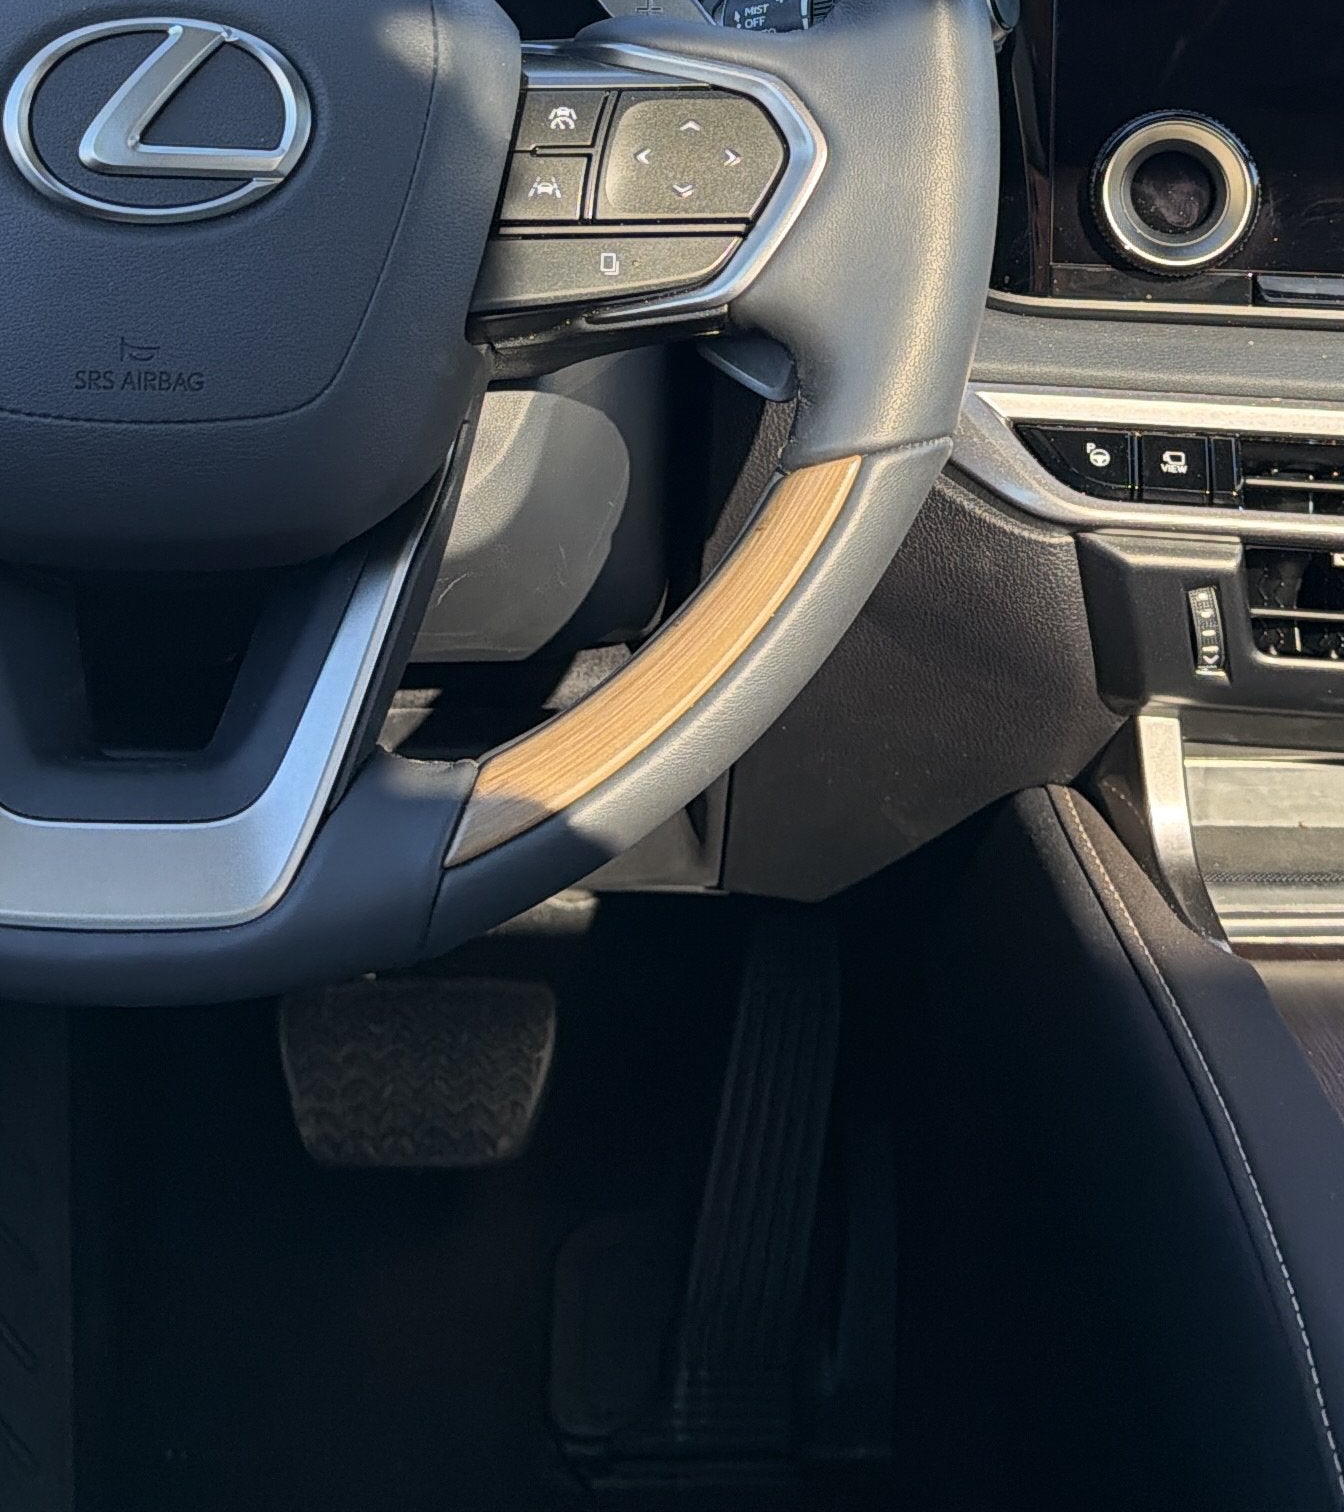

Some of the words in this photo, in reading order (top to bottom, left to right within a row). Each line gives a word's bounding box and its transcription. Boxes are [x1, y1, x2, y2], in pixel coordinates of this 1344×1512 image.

[744, 3, 769, 17] MIST
[744, 16, 766, 29] OFF
[74, 370, 115, 390] SRS
[121, 371, 205, 392] AIRBAG
[1160, 463, 1188, 474] VIEW
